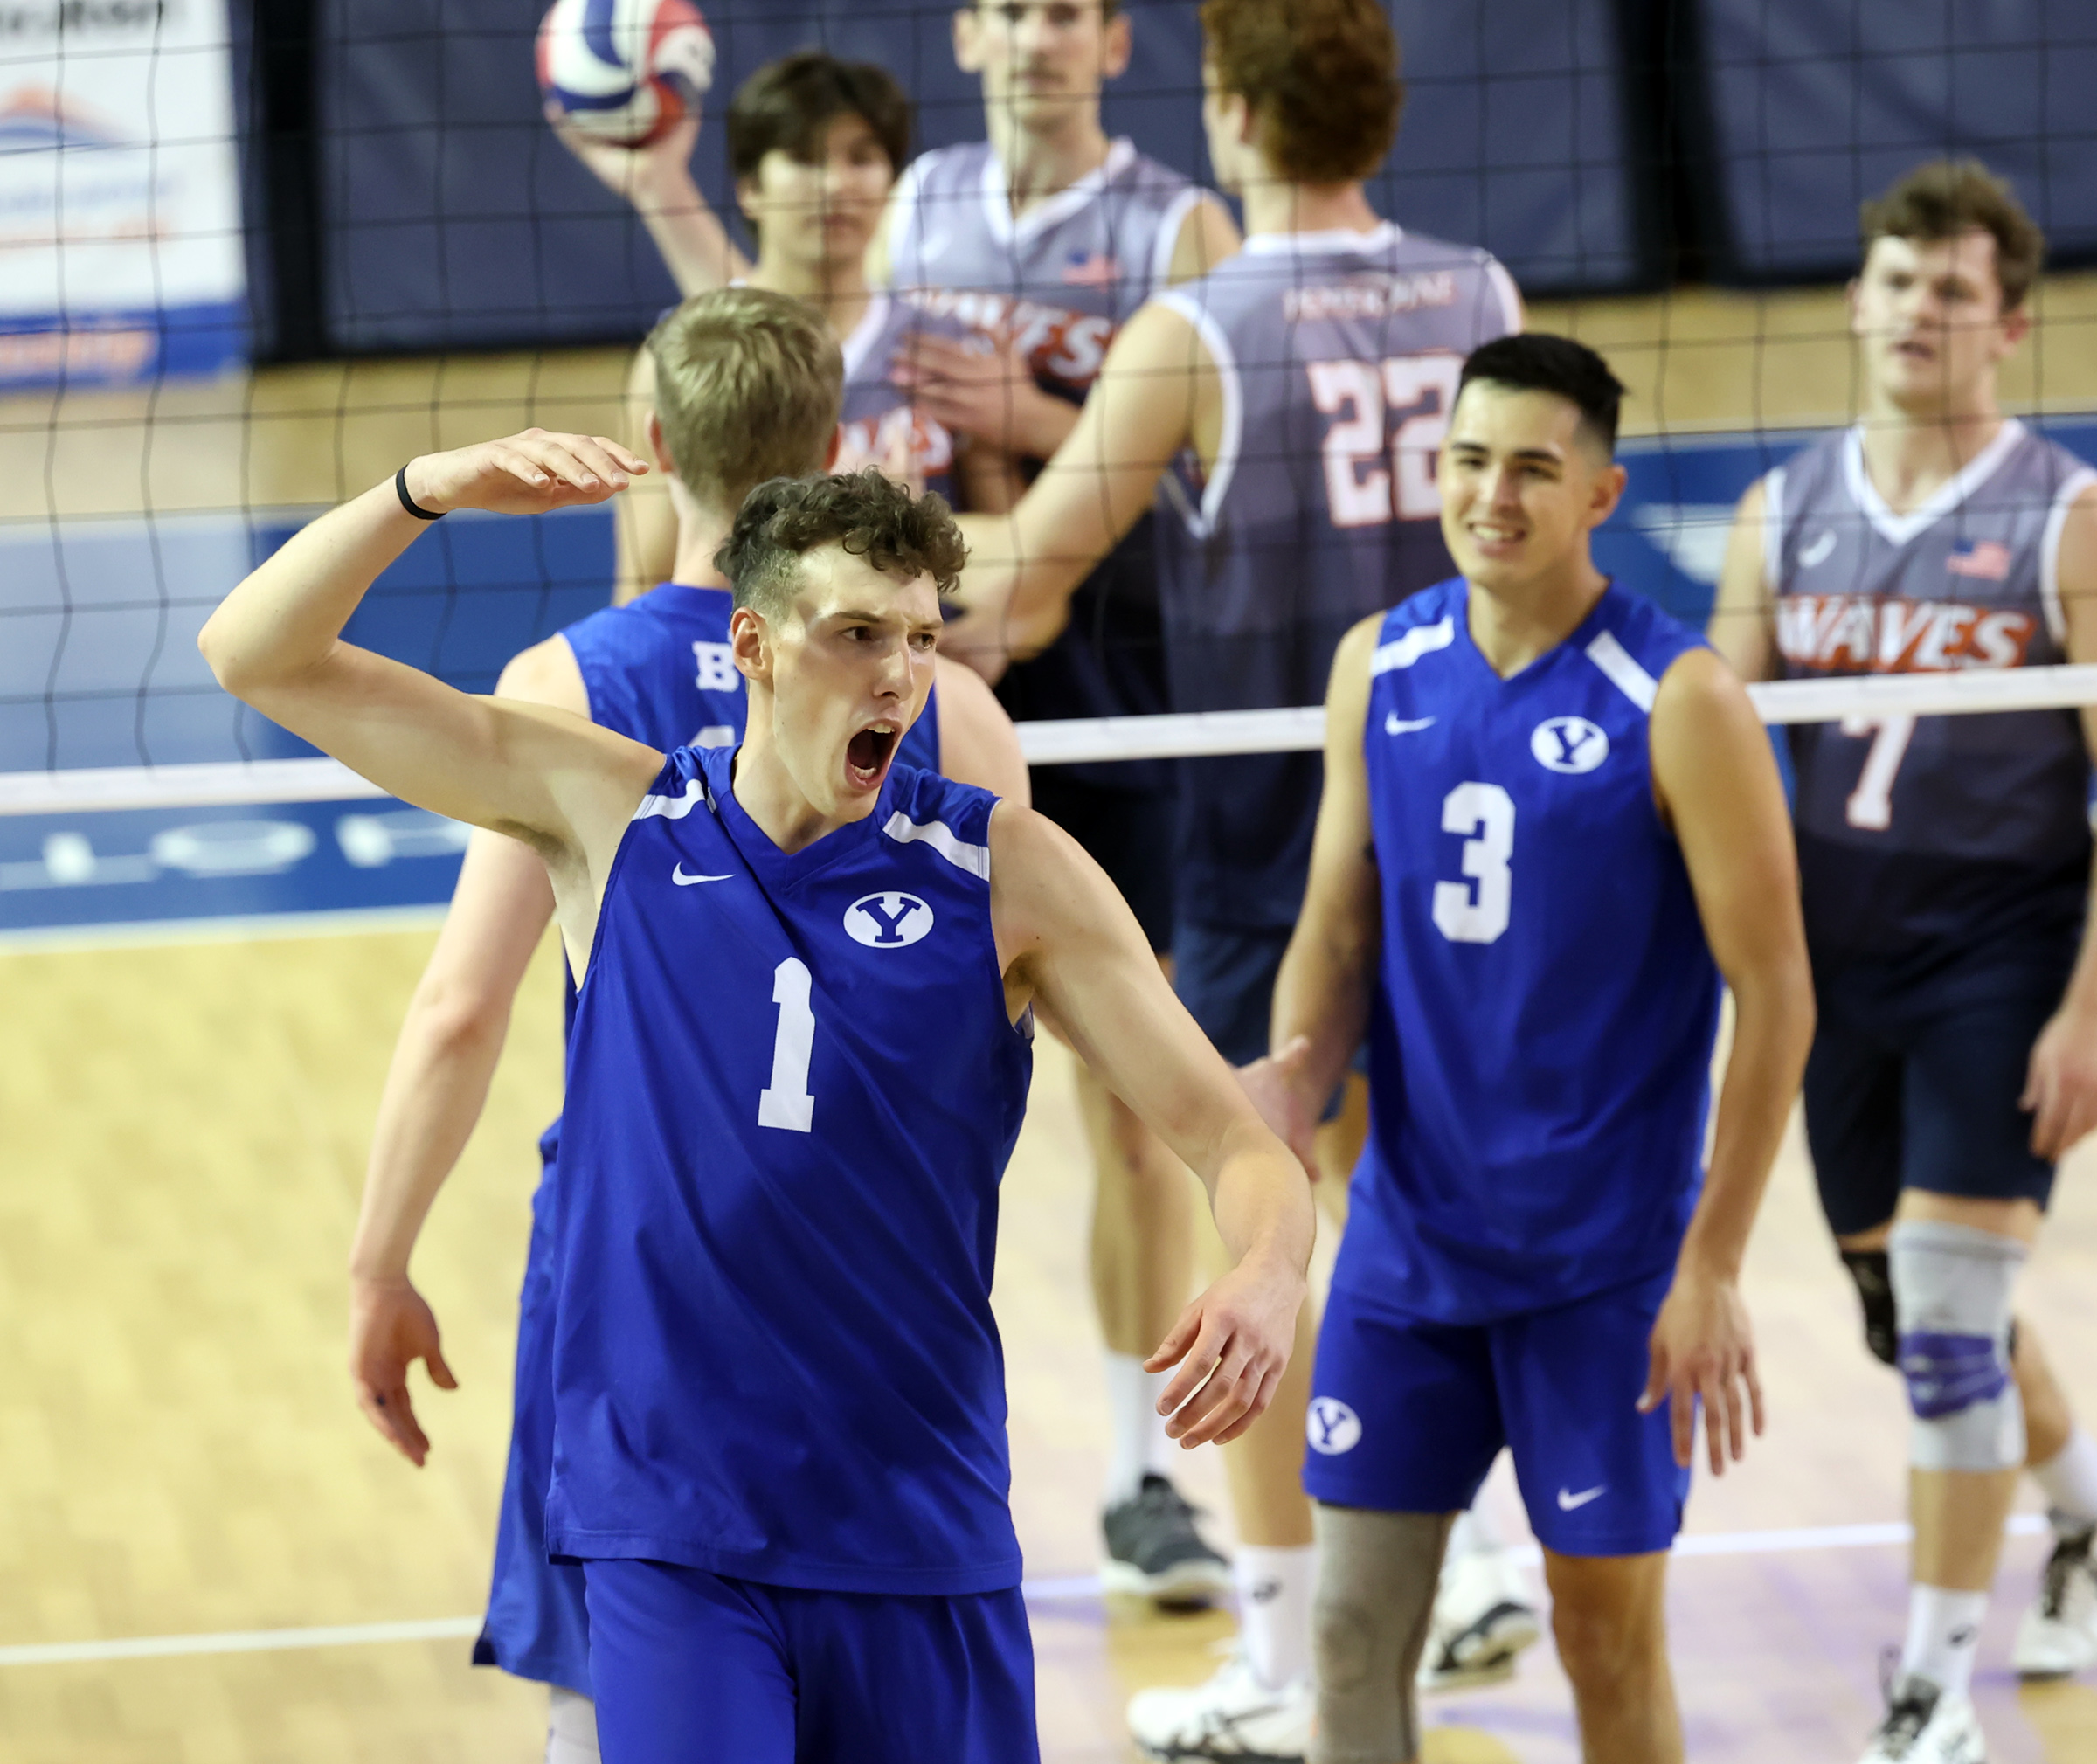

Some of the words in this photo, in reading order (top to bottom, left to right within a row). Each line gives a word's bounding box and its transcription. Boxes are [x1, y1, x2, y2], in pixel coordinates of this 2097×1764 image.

[1307, 353, 1464, 528] 22
[1775, 594, 2038, 673] WAVES
[1840, 713, 1918, 830] 7
[1432, 780, 1516, 944] 3
[758, 956, 816, 1133] 1
